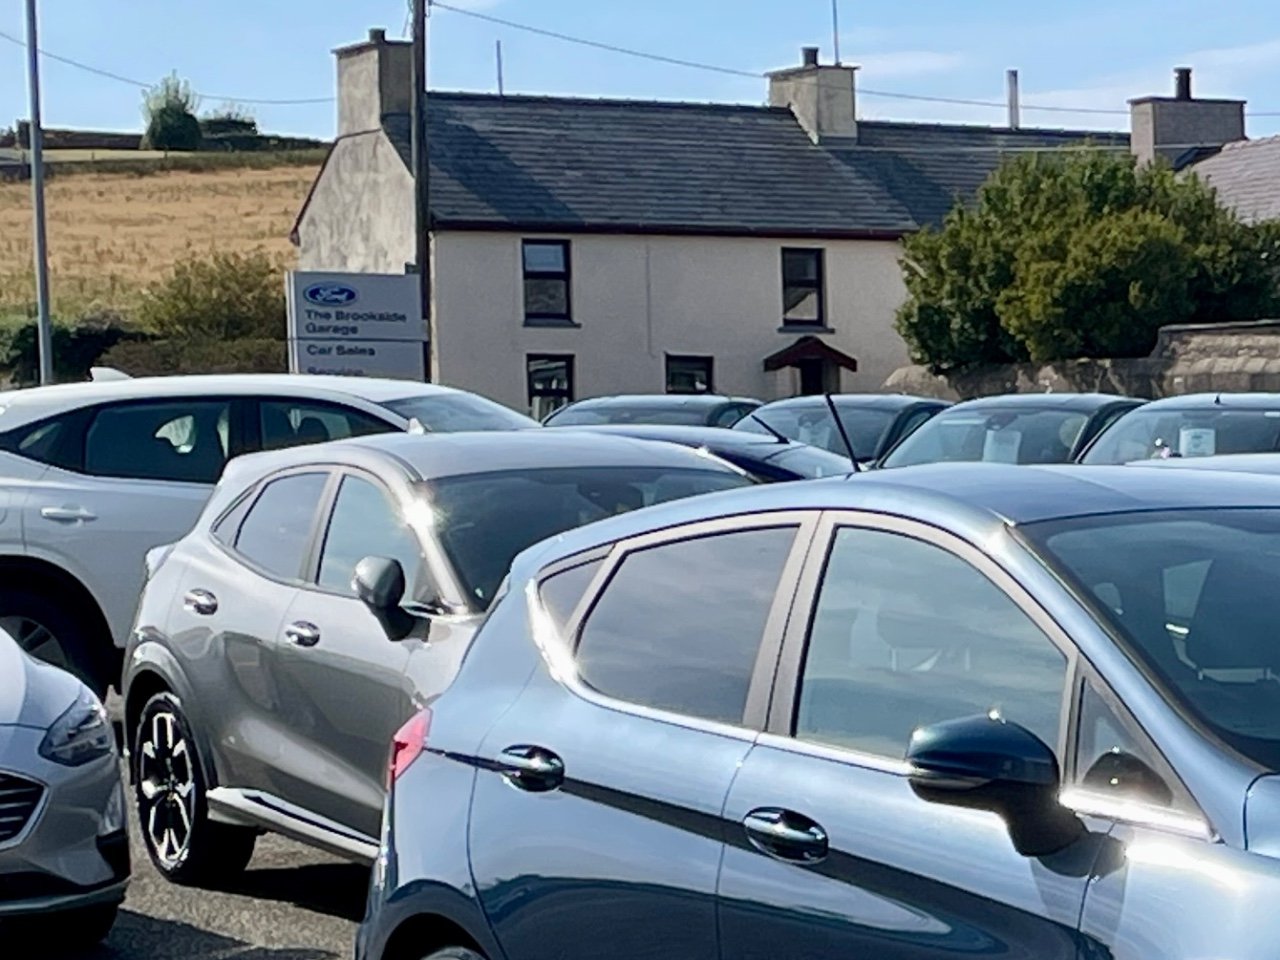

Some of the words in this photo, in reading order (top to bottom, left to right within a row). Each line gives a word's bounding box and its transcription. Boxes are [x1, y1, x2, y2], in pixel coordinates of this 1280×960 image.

[304, 309, 332, 321] The
[335, 310, 407, 323] Brookside
[305, 323, 359, 335] Garage
[306, 344, 332, 356] Car
[336, 345, 376, 356] Sales
